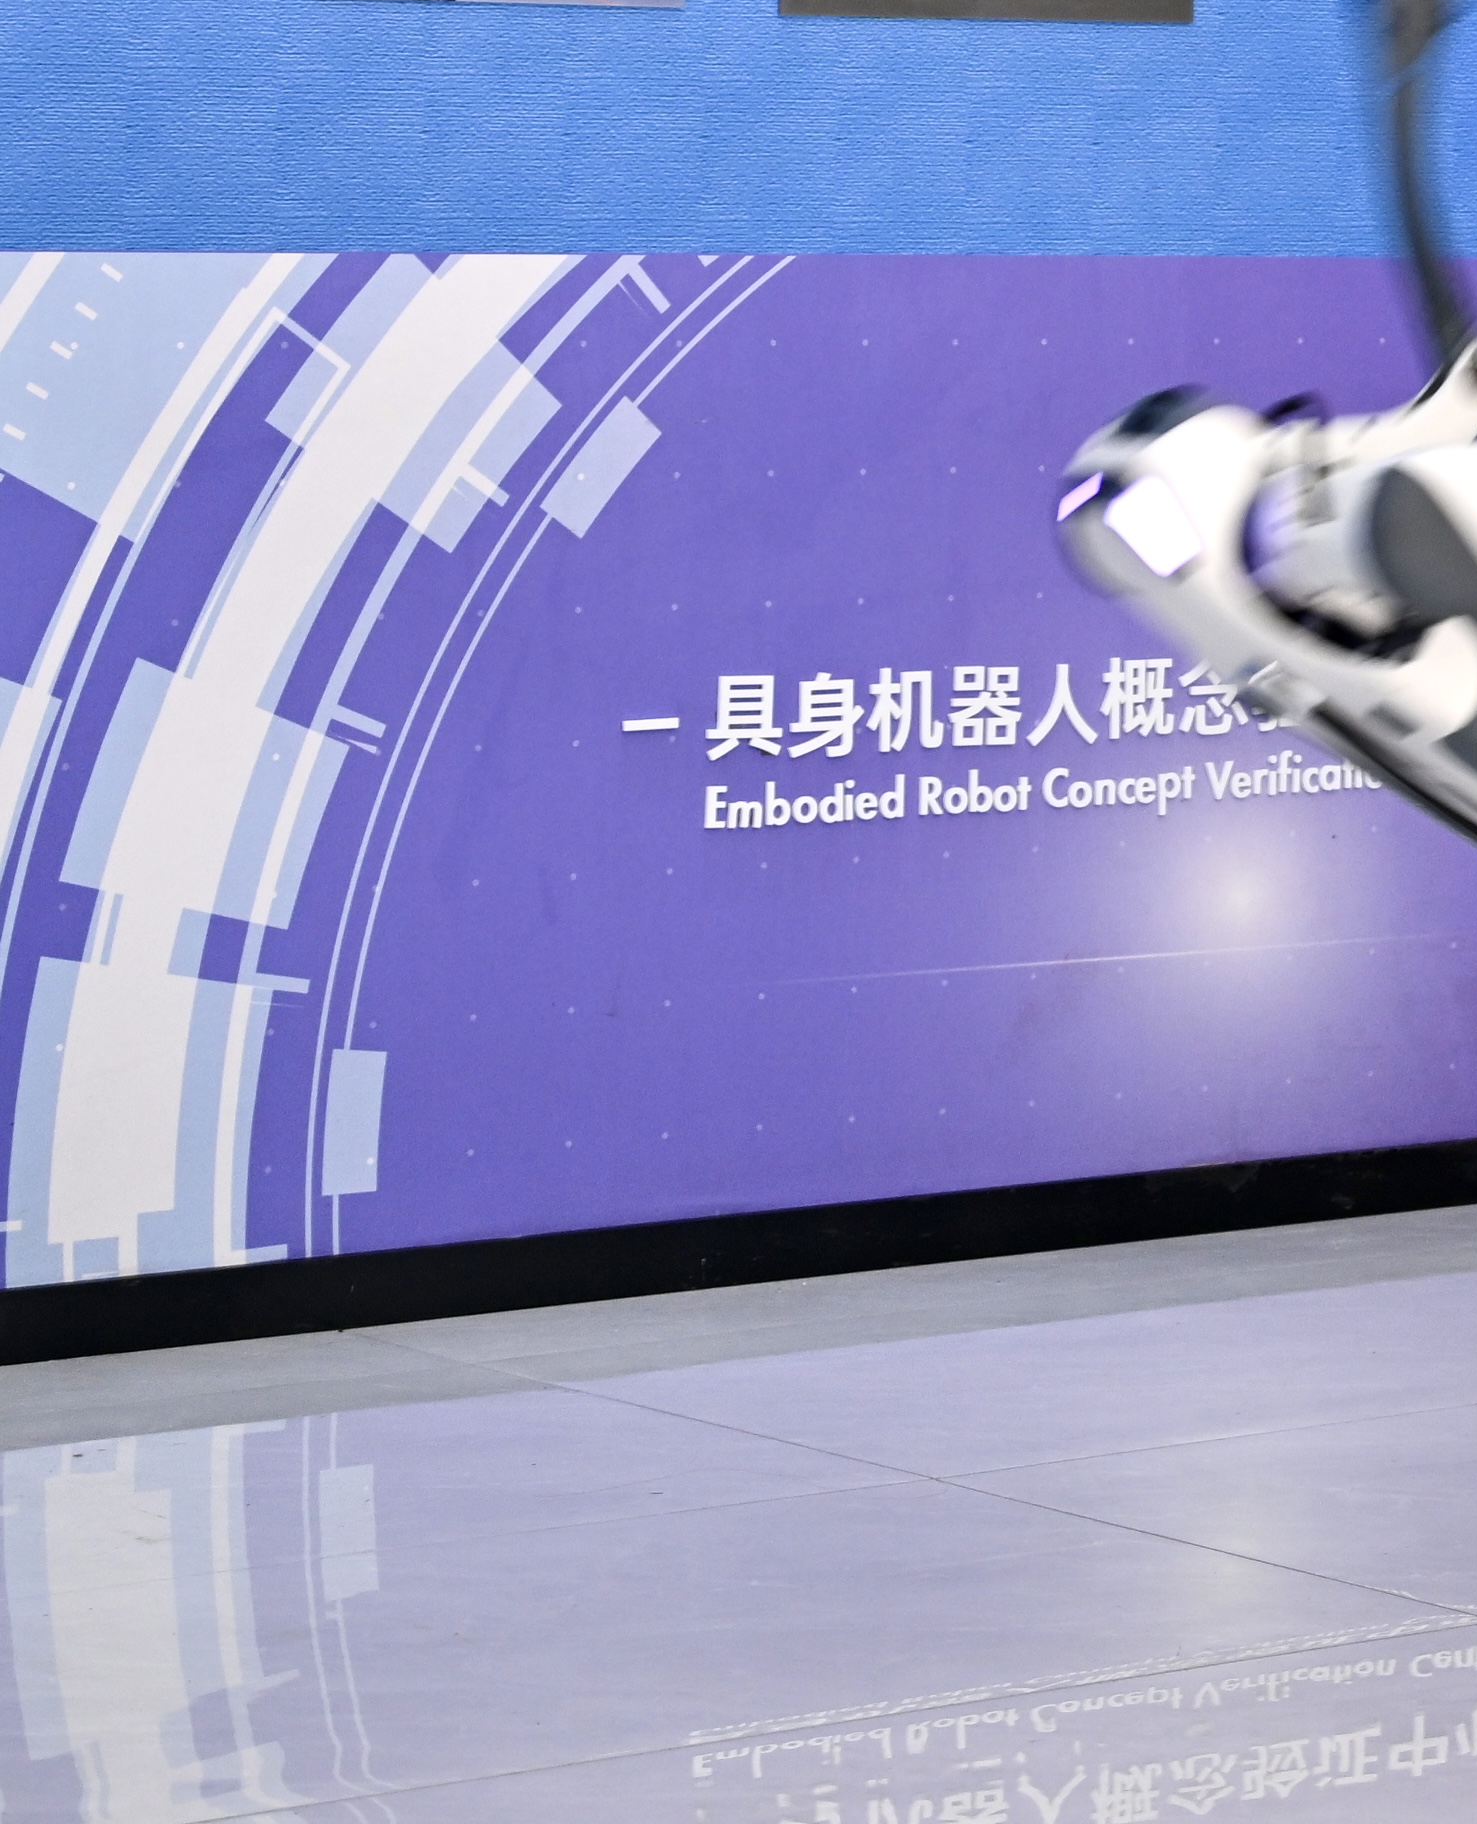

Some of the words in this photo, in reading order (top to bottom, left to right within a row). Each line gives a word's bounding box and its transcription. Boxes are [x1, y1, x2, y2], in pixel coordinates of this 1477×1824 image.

[704, 656, 1302, 762] 具身机器人概念
[703, 774, 906, 831] Embodied
[917, 769, 1033, 817] Robot
[1041, 761, 1196, 817] Concept
